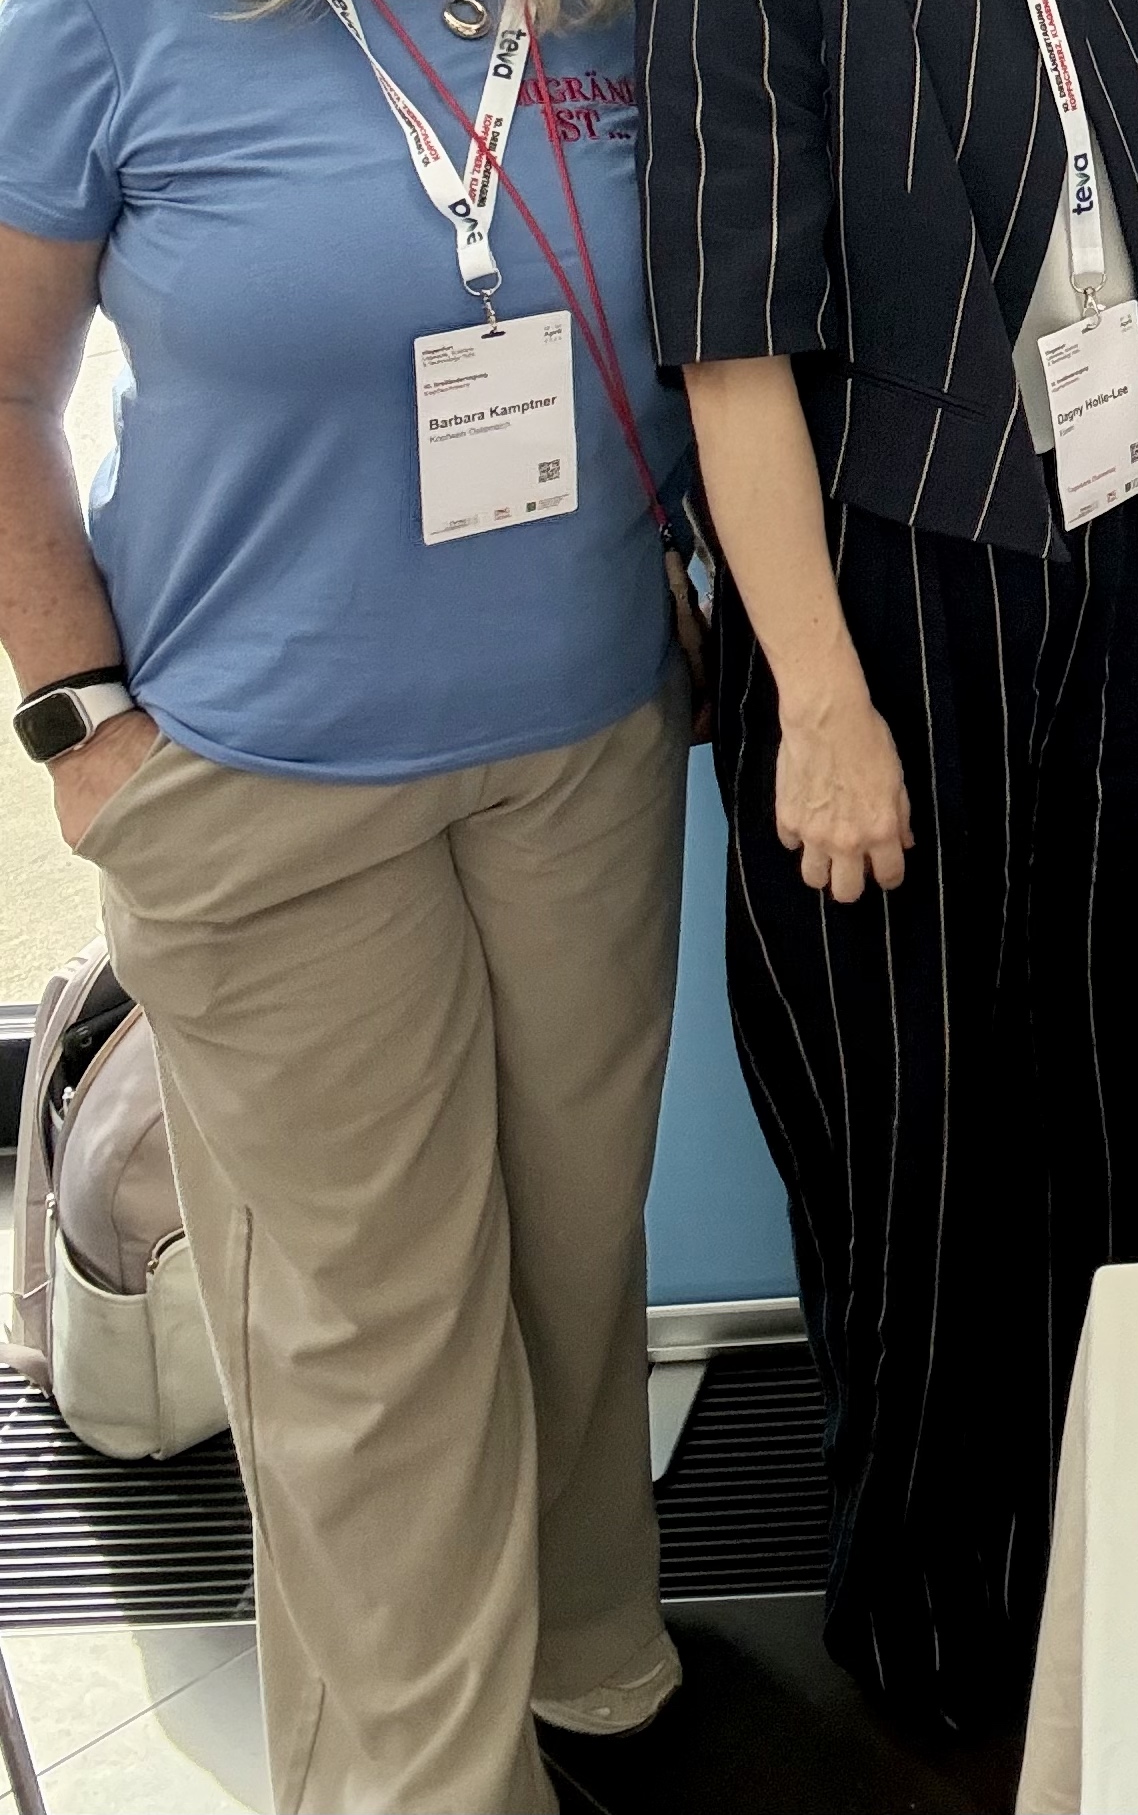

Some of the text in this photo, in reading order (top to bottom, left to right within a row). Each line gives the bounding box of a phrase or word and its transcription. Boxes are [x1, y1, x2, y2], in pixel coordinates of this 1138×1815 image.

[492, 29, 527, 80] teva
[1072, 152, 1094, 216] teva
[448, 197, 484, 246] eva
[429, 395, 557, 431] Barbara Kamptner
